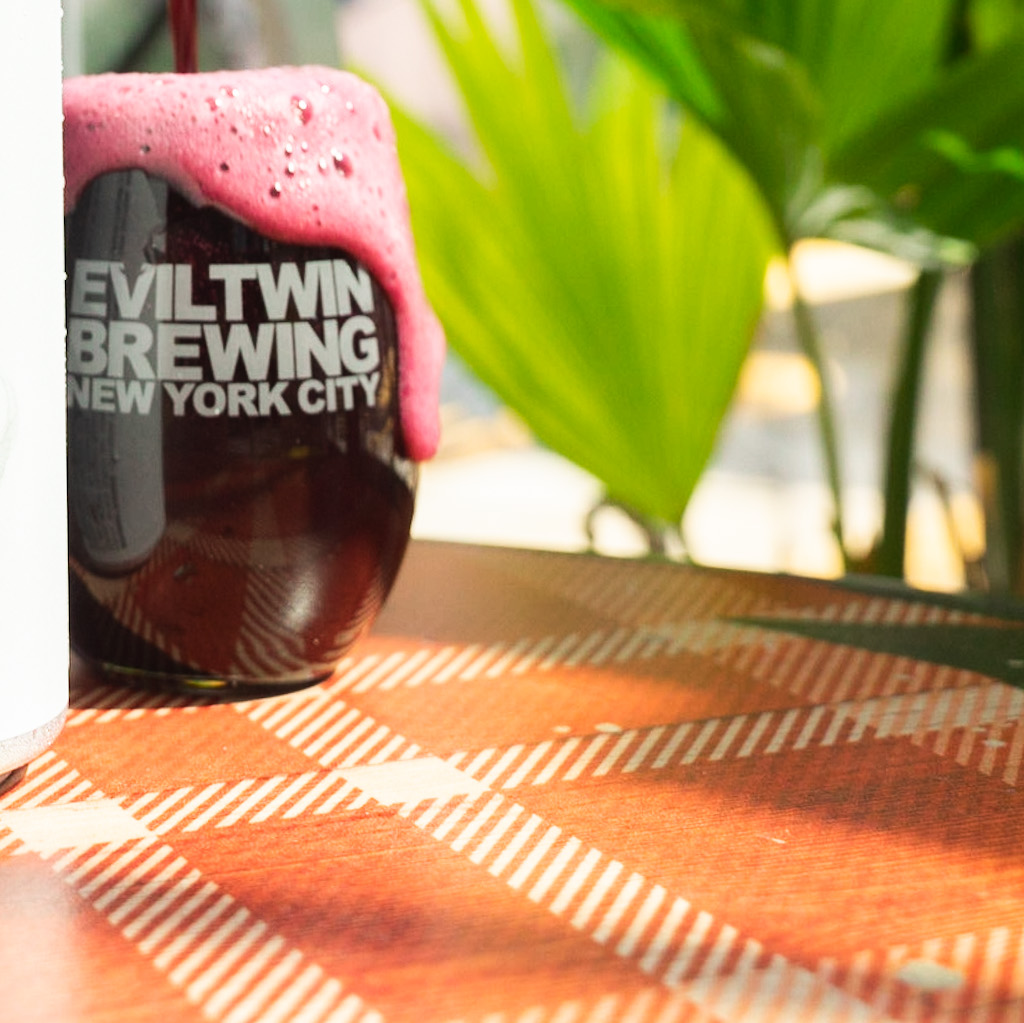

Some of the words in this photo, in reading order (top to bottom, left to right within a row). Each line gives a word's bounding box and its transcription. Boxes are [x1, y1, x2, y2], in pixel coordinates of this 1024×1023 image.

[67, 315, 380, 381] BREWING
[67, 374, 155, 415] NEW
[162, 382, 291, 417] YORK
[297, 372, 380, 414] CITY
